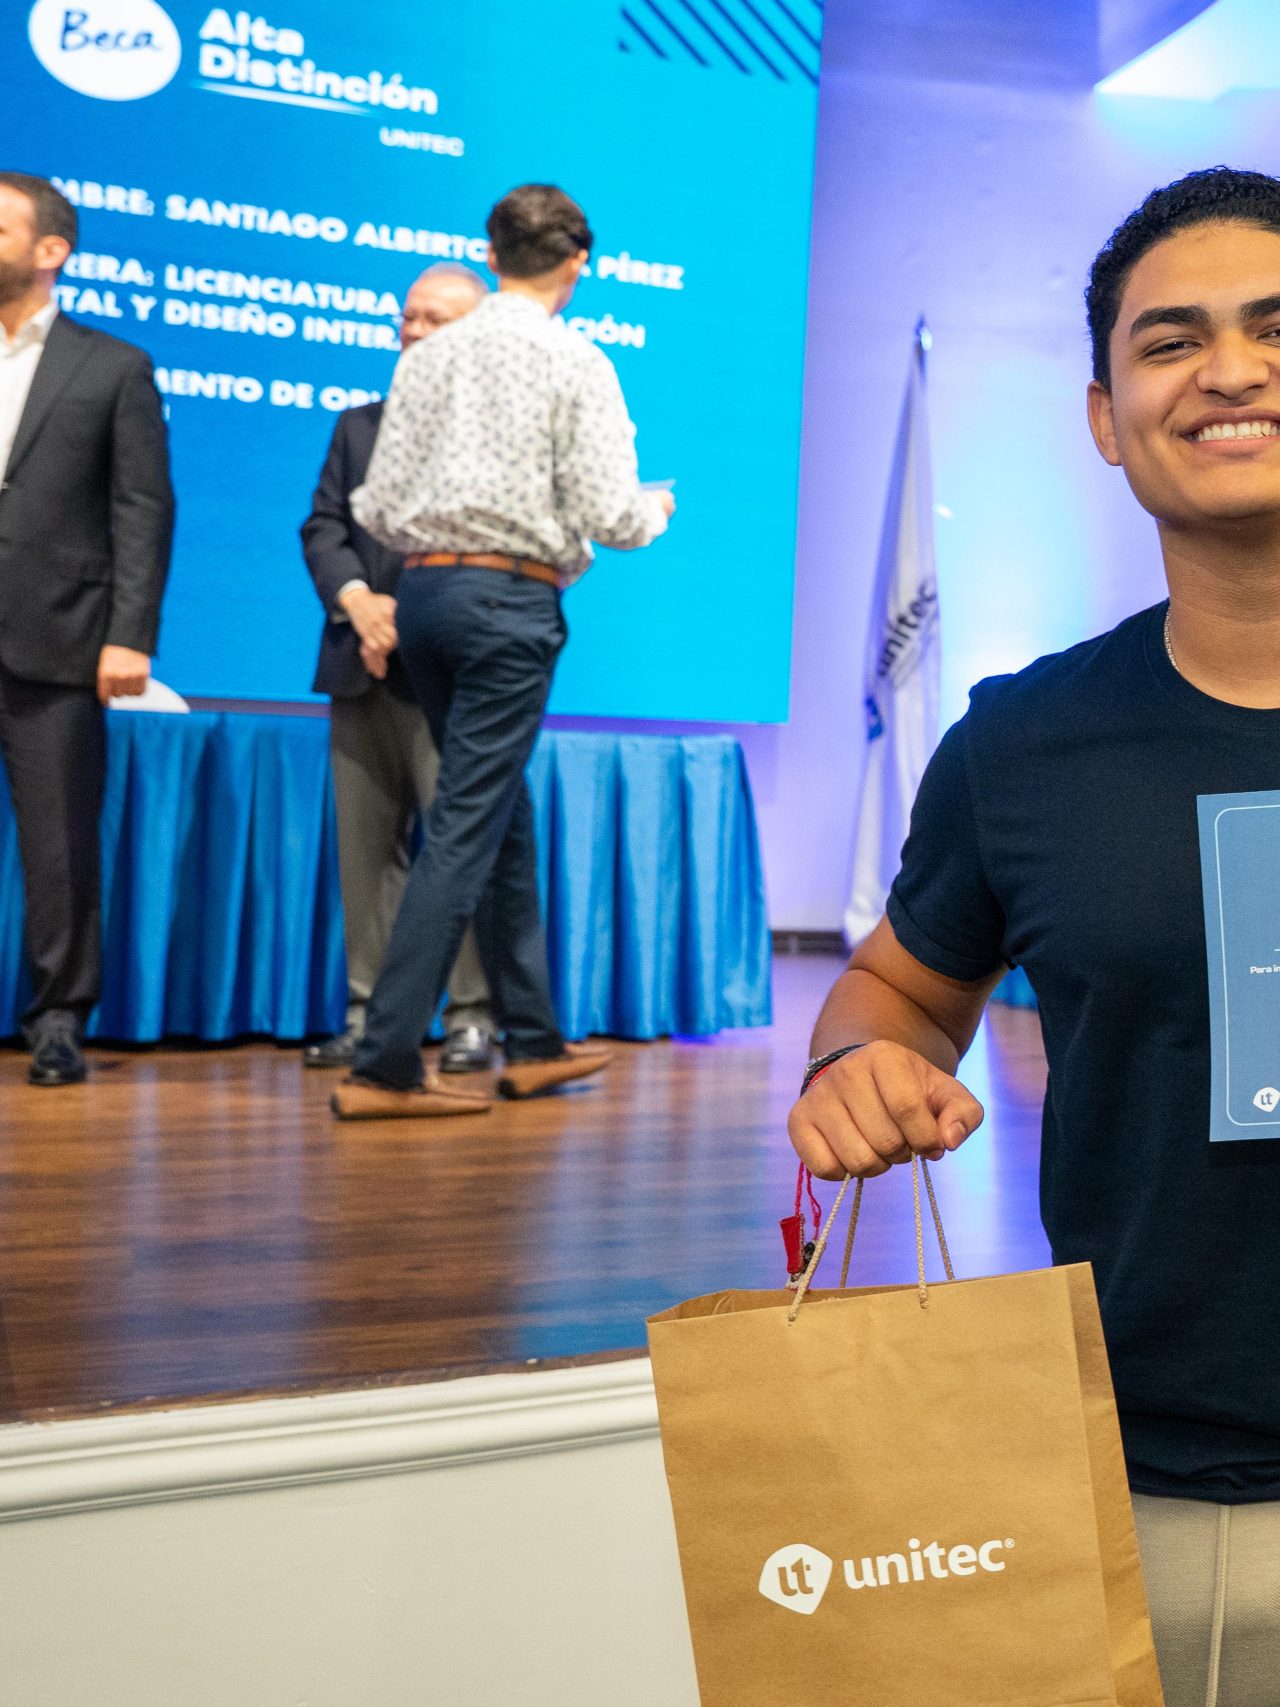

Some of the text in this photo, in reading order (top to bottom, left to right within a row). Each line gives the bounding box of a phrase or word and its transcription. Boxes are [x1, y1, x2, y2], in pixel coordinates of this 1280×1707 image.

[60, 9, 162, 52] Beca
[199, 8, 304, 56] Alta
[199, 43, 438, 115] Distinción
[380, 126, 465, 156] UNITEC
[51, 176, 154, 216] MBRE:
[165, 194, 348, 243] SANTIAGO
[597, 251, 684, 290] PÉREZ
[165, 263, 400, 316] LICENCIATURA
[130, 293, 158, 321] Y
[164, 298, 296, 338] DISEÑO
[302, 315, 402, 351] INTER
[270, 379, 314, 409] DE
[1249, 966, 1273, 974] Para
